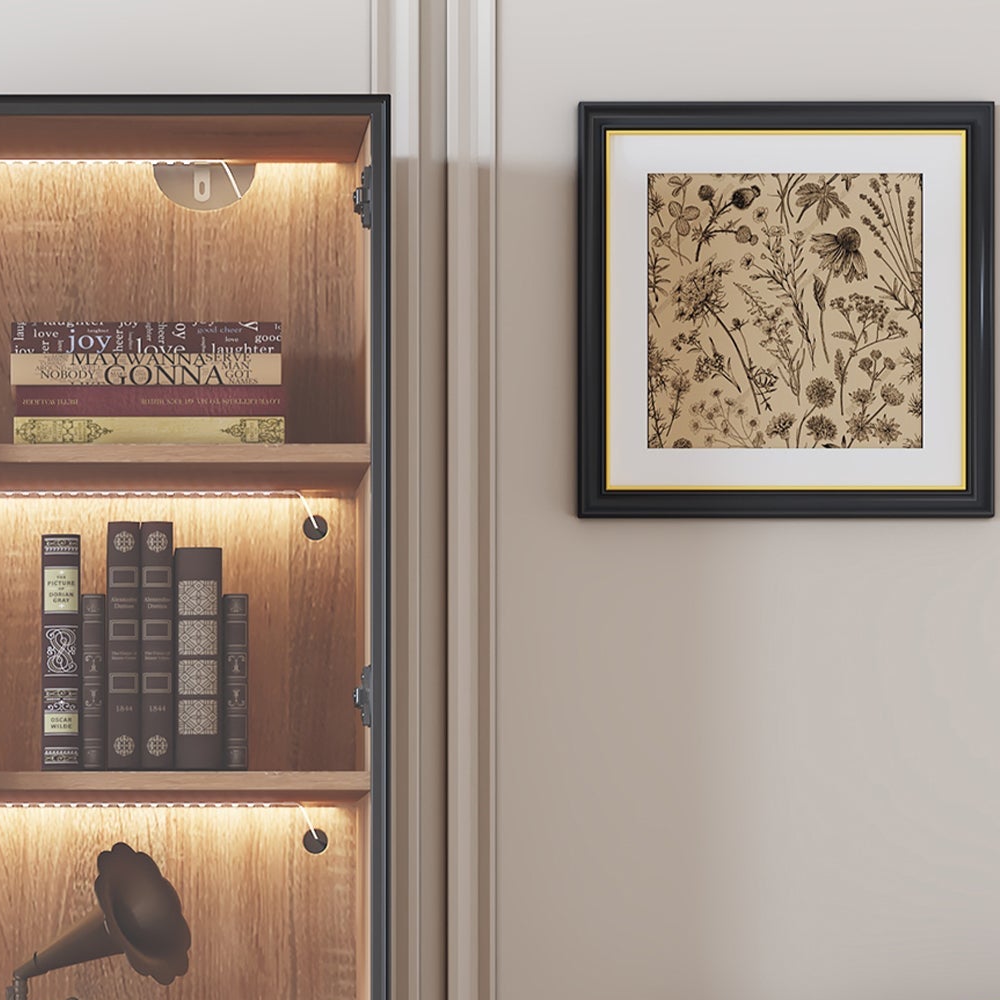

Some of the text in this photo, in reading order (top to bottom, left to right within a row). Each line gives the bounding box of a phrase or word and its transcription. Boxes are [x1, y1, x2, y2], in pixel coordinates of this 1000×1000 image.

[33, 329, 59, 338] love
[66, 329, 112, 353] joy
[137, 337, 186, 353] love
[212, 343, 274, 353] laughter
[70, 353, 121, 365] MAY
[126, 353, 206, 365] WANNA
[205, 353, 251, 361] SERVE
[222, 361, 249, 369] MAN
[41, 370, 96, 379] NOBODY
[104, 365, 225, 385] GONNA
[225, 369, 252, 378] GOT
